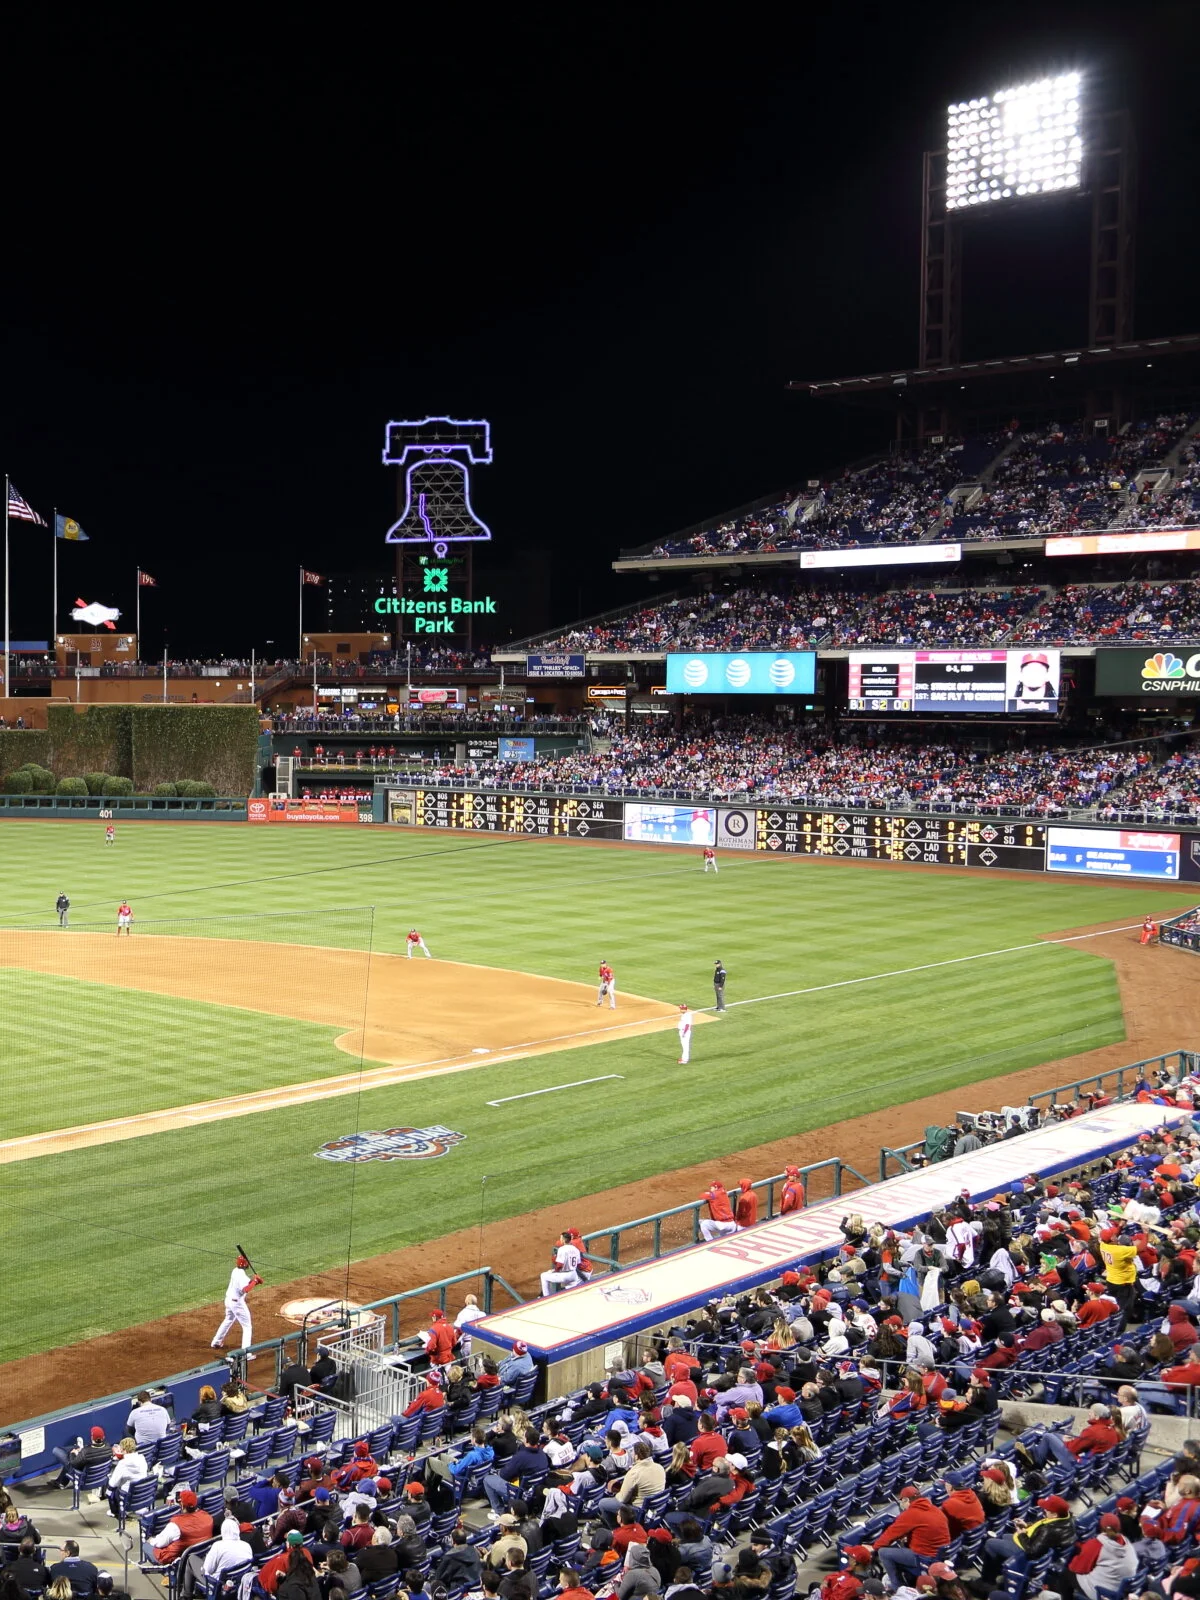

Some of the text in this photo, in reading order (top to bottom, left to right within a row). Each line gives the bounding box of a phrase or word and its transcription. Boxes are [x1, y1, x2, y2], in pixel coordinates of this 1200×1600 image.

[374, 596, 496, 614] Citizens Bank
[415, 616, 454, 633] Park
[319, 688, 357, 696] SEASONS PIZZA
[99, 809, 113, 819] 401
[286, 813, 340, 821] buyatoyota.com
[359, 813, 373, 823] 398
[592, 811, 604, 819] LAA
[786, 812, 798, 821] CIN
[537, 817, 549, 825] OAK
[852, 816, 868, 825] CHC
[925, 820, 940, 829] CLE
[538, 826, 548, 834] TEX
[785, 822, 798, 831] STL
[853, 827, 866, 835] MIL
[1004, 825, 1015, 834] SF
[785, 834, 798, 842] ATL
[925, 831, 939, 840] ARI
[853, 838, 867, 847] MIA
[1003, 836, 1015, 845] SD
[785, 843, 796, 852] PIT
[924, 843, 940, 852] LAD
[851, 848, 868, 857] NYM
[923, 853, 939, 862] COL
